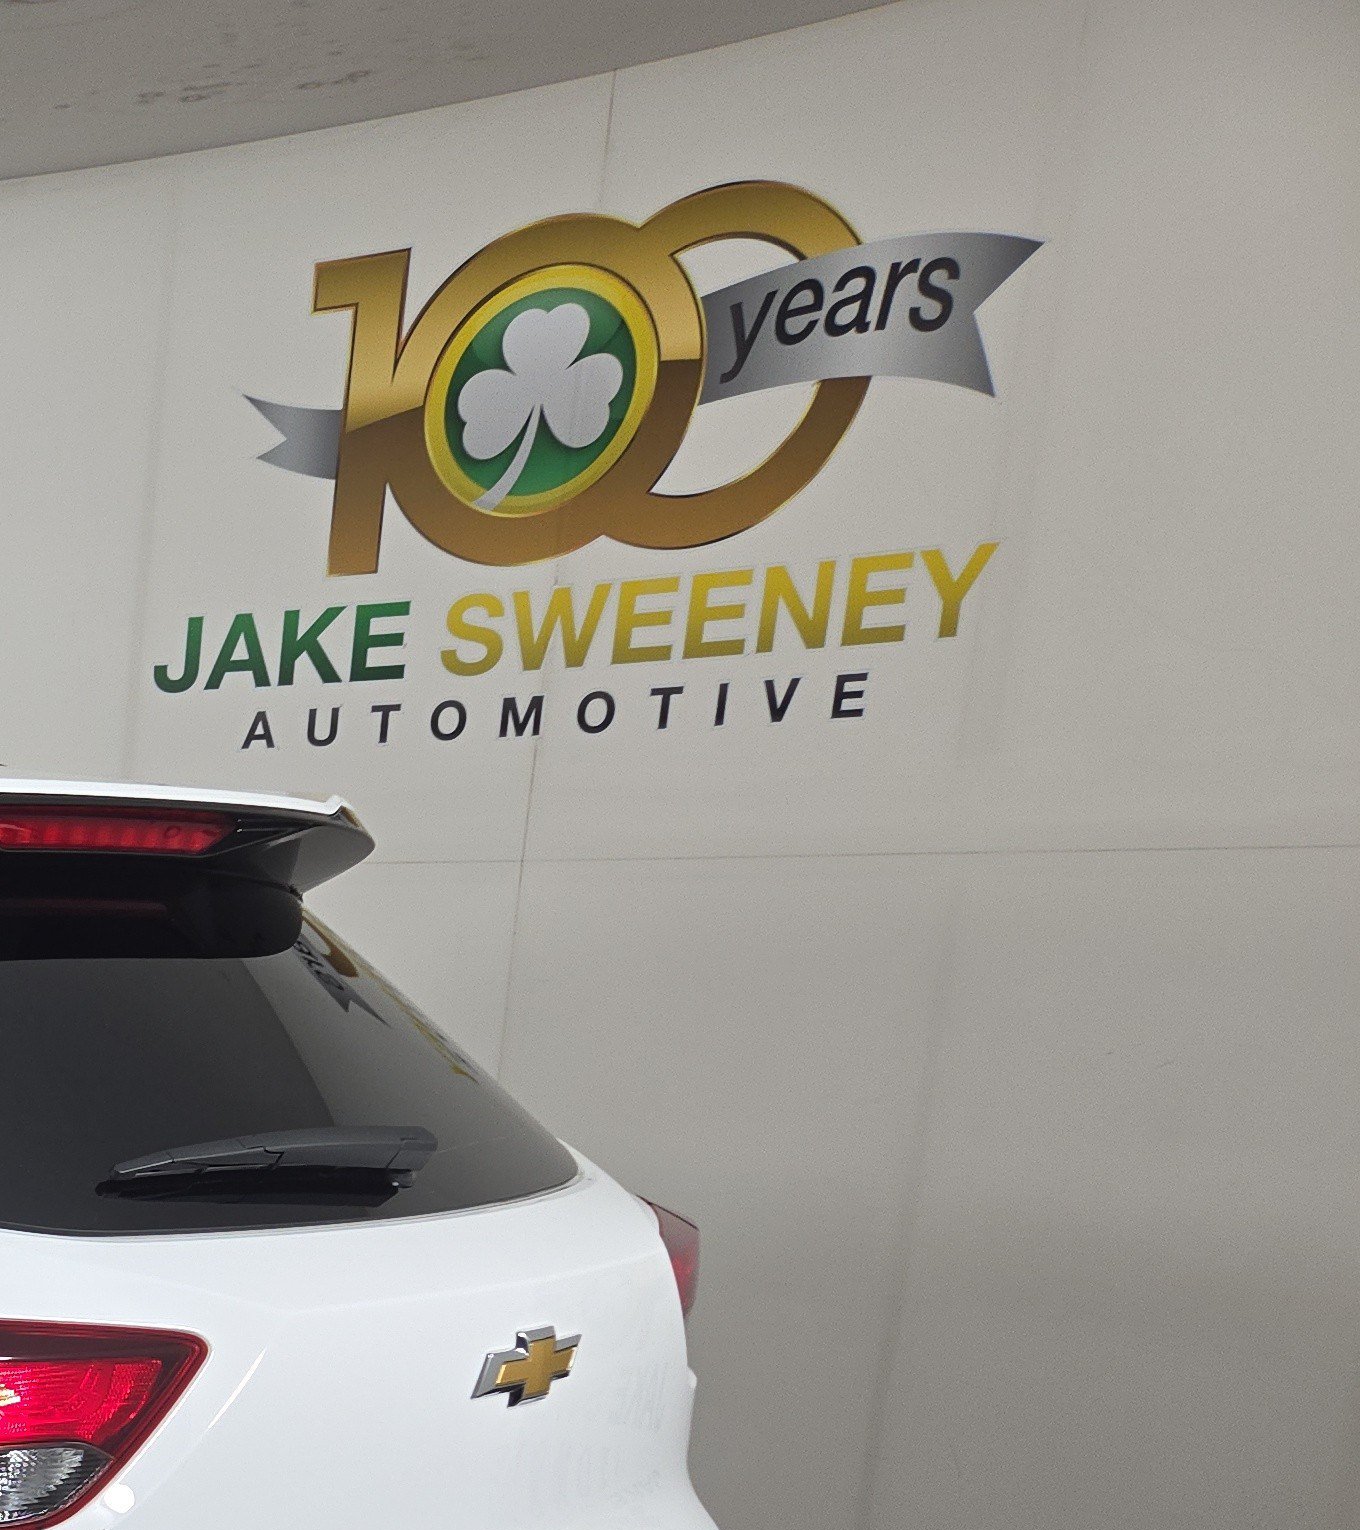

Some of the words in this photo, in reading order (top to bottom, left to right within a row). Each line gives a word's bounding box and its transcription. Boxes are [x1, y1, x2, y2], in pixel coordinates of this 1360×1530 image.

[312, 180, 872, 577] 100
[719, 255, 960, 385] years
[153, 601, 411, 693] JAKE
[441, 542, 1000, 677] SWEENEY
[241, 672, 870, 750] AUTOMOTIVE
